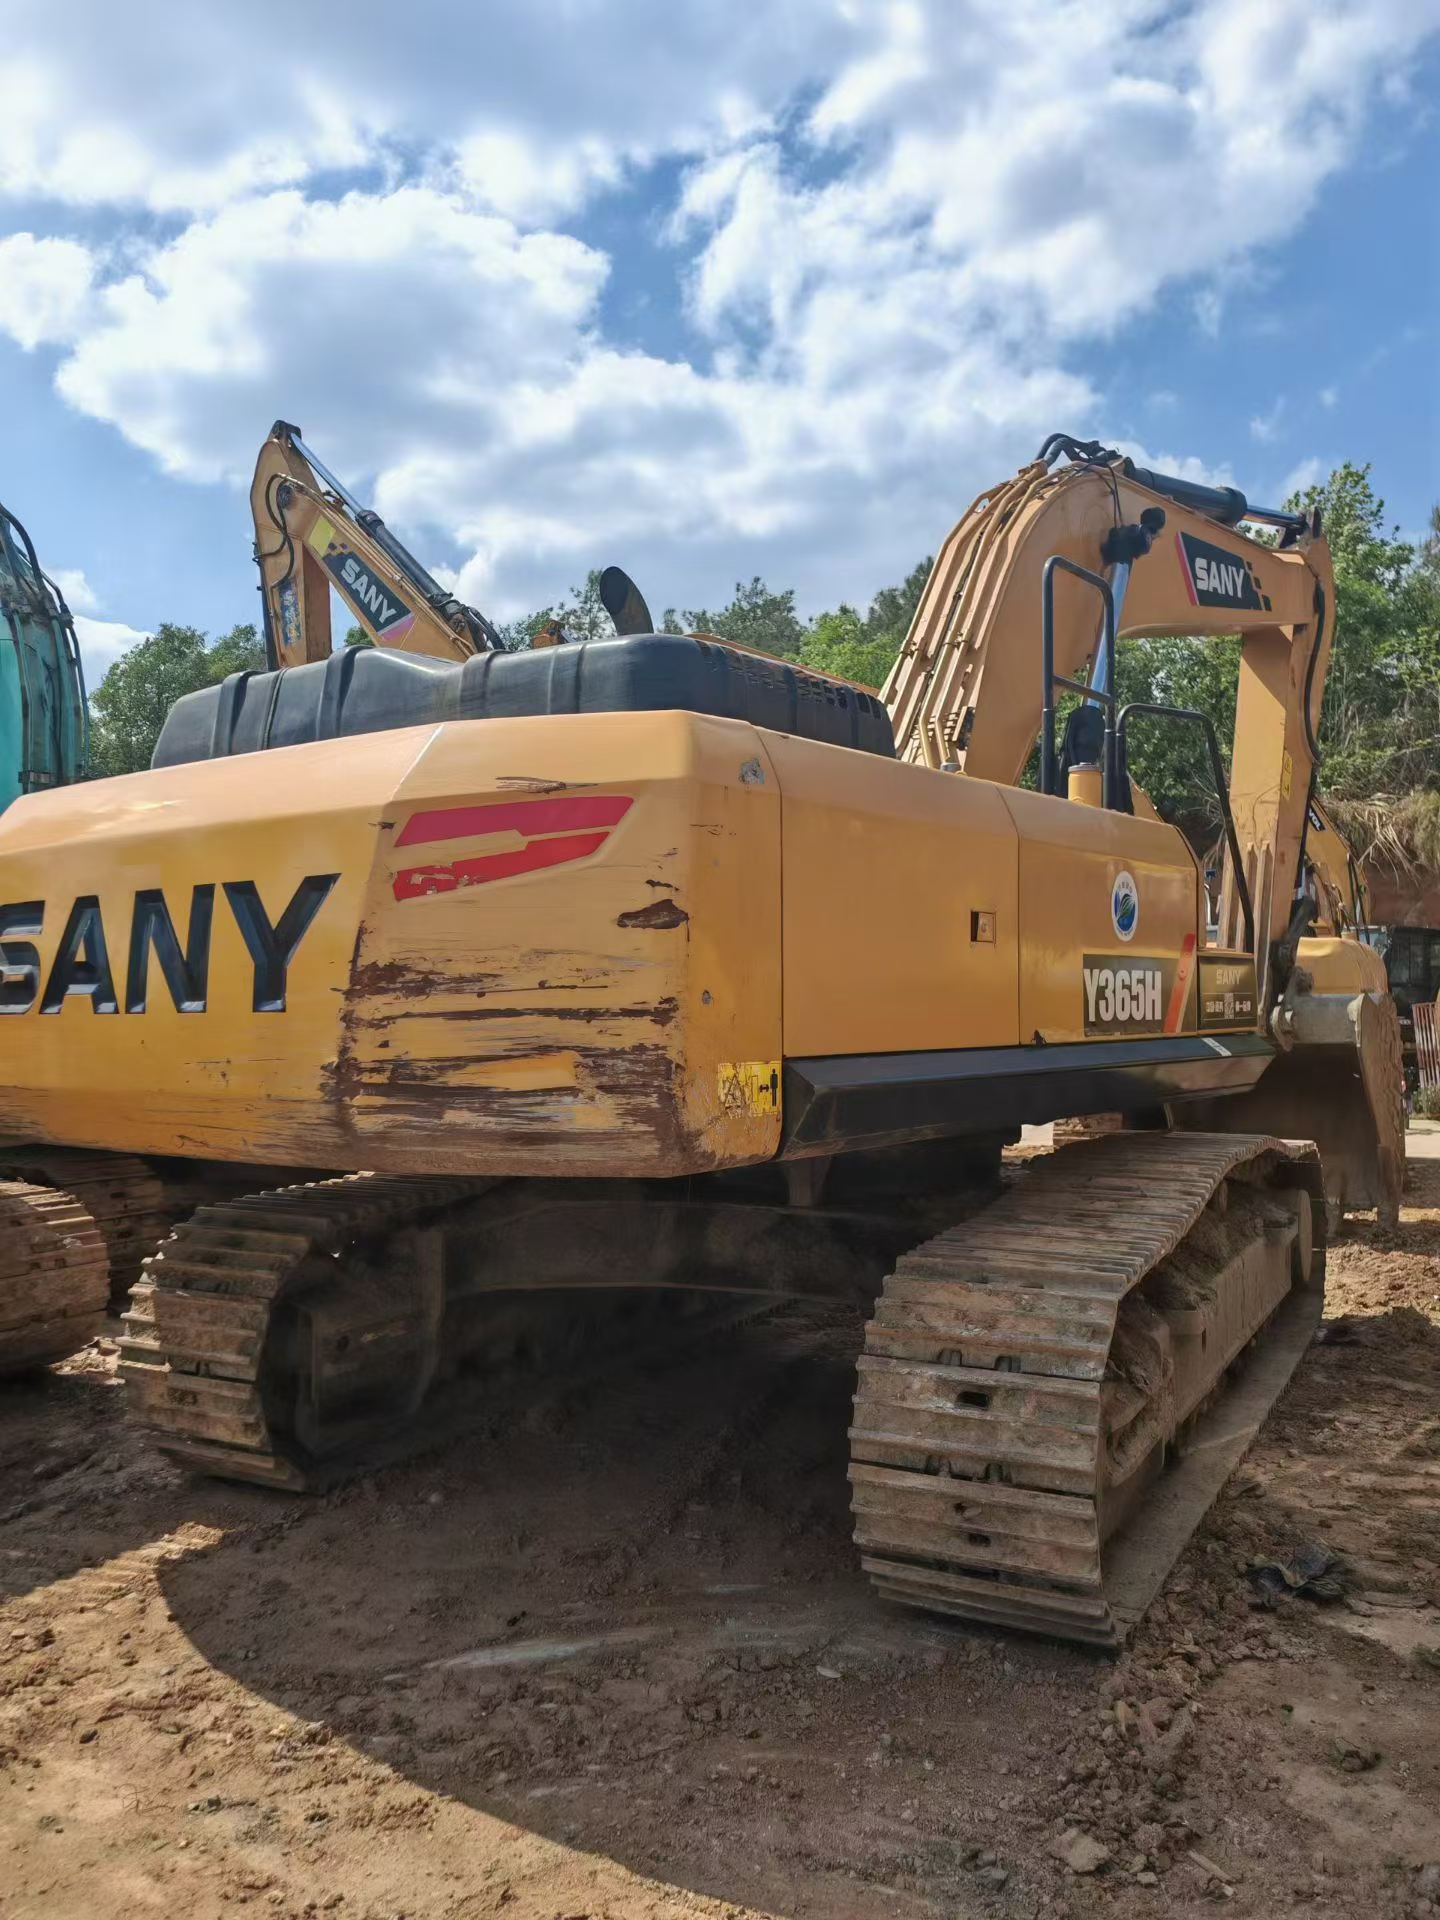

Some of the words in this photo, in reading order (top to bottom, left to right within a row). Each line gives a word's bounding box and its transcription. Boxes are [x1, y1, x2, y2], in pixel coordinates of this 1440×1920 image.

[340, 558, 397, 624] SANY
[1195, 557, 1245, 599] SANY
[0, 873, 342, 1015] SANY
[1083, 968, 1162, 1022] Y365H
[1216, 968, 1241, 985] SANY
